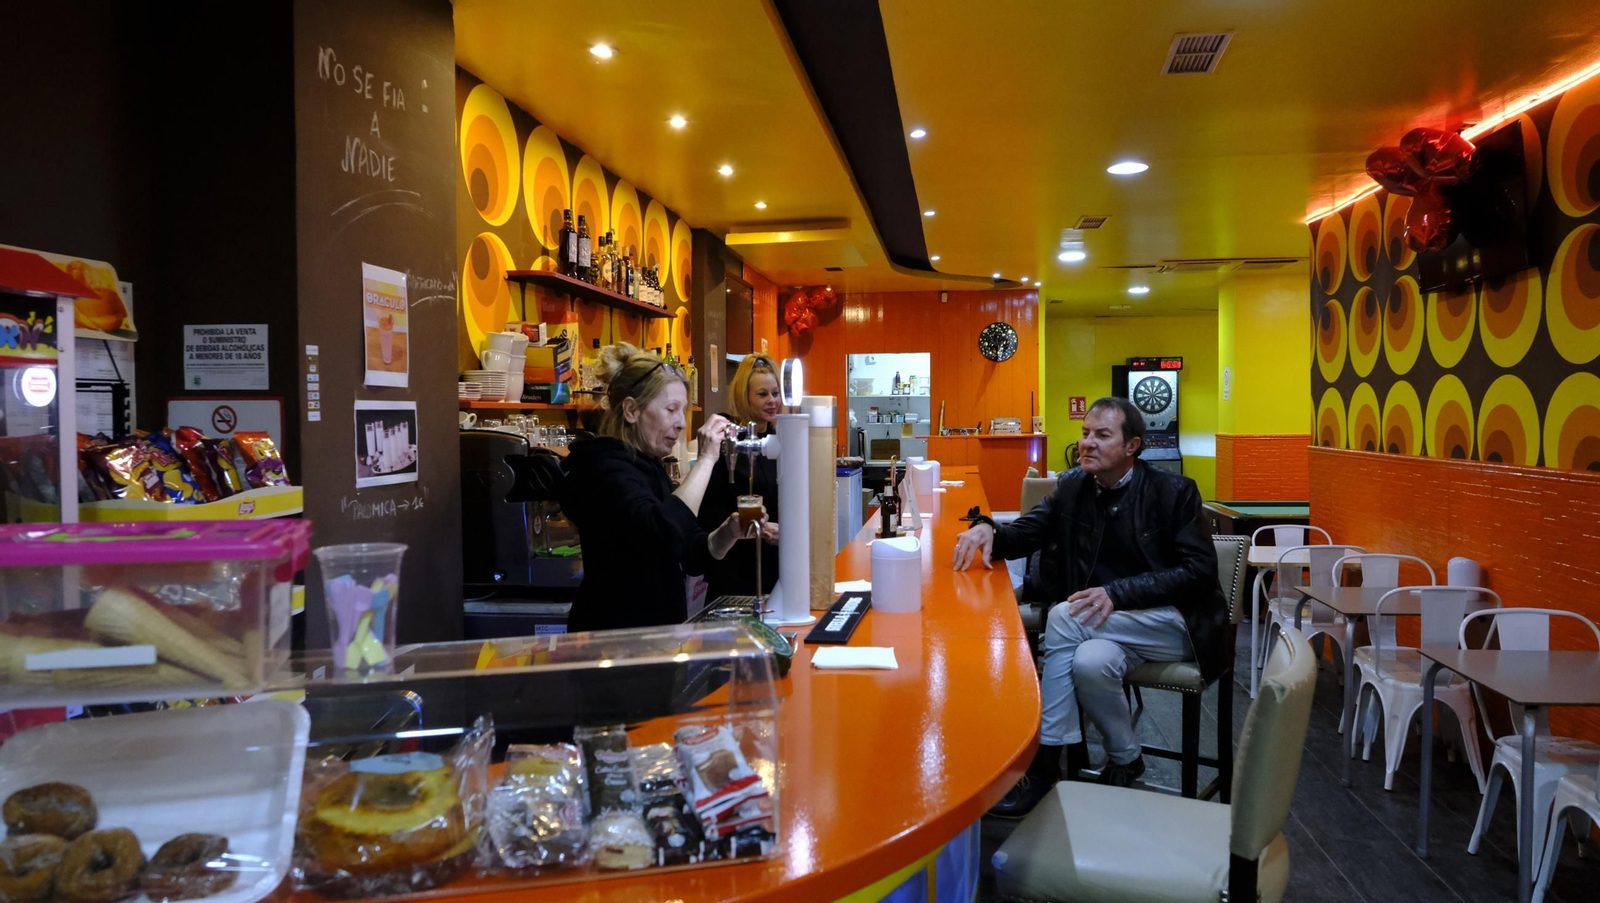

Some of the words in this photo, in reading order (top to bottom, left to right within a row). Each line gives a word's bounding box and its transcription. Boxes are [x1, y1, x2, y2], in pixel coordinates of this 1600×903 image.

[318, 46, 345, 86] NO
[352, 65, 374, 99] SE
[382, 81, 405, 111] FIA
[370, 111, 381, 138] A
[341, 136, 395, 182] NADIE
